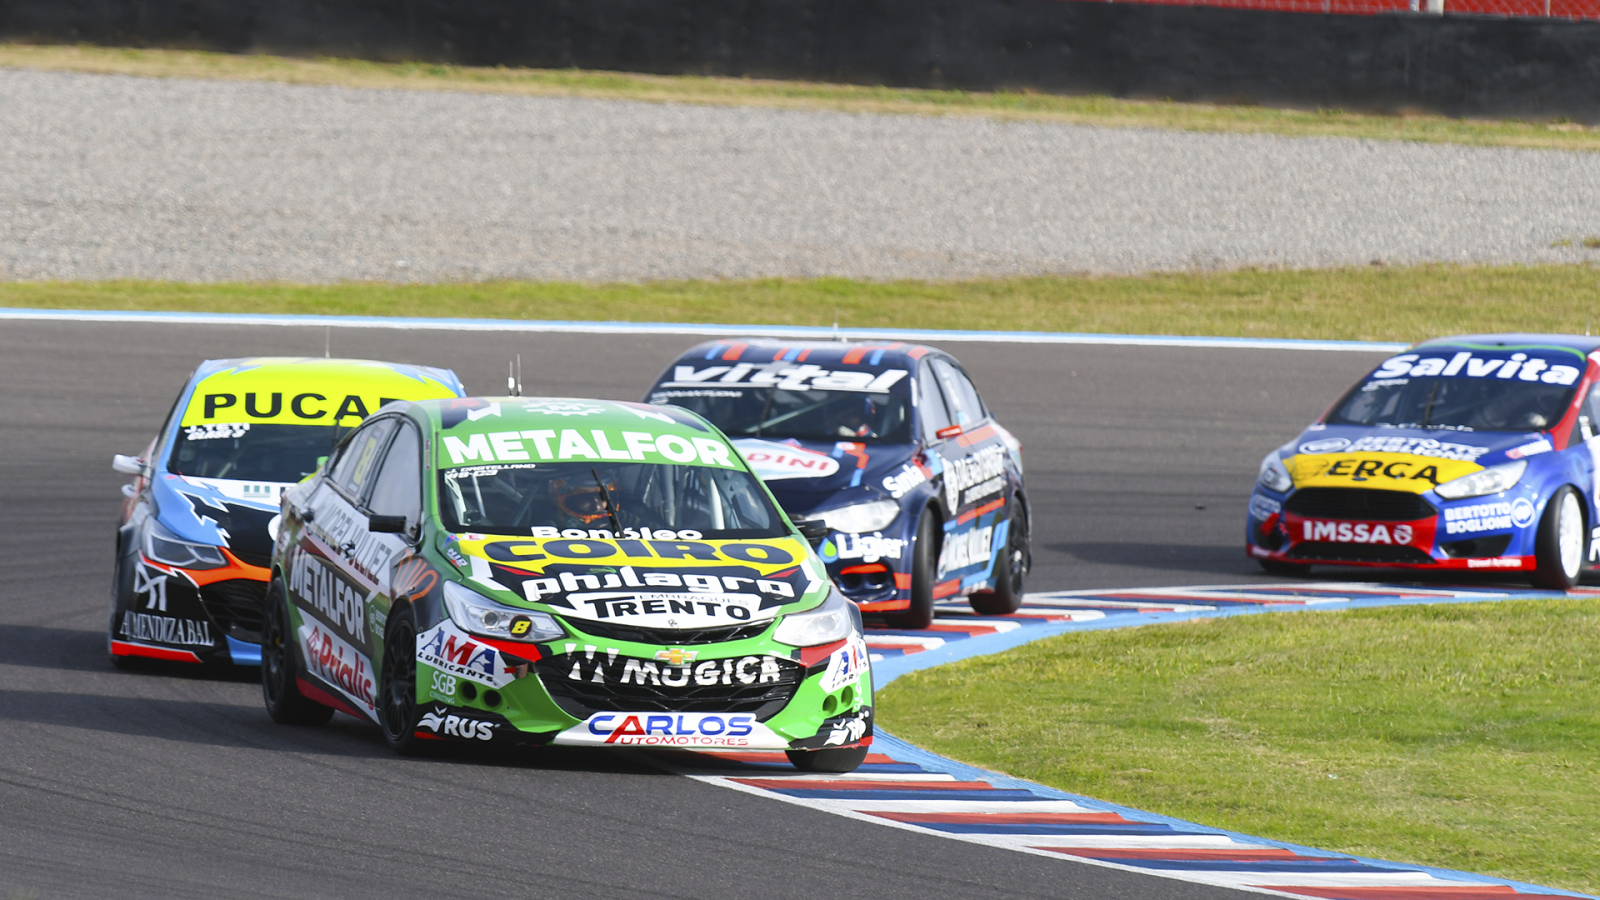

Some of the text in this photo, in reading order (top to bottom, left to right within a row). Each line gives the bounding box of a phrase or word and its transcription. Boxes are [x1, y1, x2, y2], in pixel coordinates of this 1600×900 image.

[673, 363, 909, 392] vittal
[1373, 351, 1580, 385] Salvita
[204, 392, 400, 419] PUCA
[442, 429, 735, 467] METALFOR
[1444, 502, 1511, 521] BERTOTTO
[1446, 515, 1513, 534] BOGLIONE
[1303, 520, 1392, 544] IMSSA
[483, 539, 794, 565] COIRO
[835, 532, 903, 563] Ligier
[289, 544, 366, 645] METALFOR
[522, 565, 796, 601] philagro
[584, 596, 751, 620] TRENTO
[639, 594, 749, 606] EMBRAGUES
[511, 621, 531, 634] 8
[421, 627, 496, 675] AMA
[417, 652, 494, 683] LUBRICANTS
[431, 670, 457, 696] SGB
[444, 715, 495, 740] RUS
[588, 715, 753, 737] CARLOS
